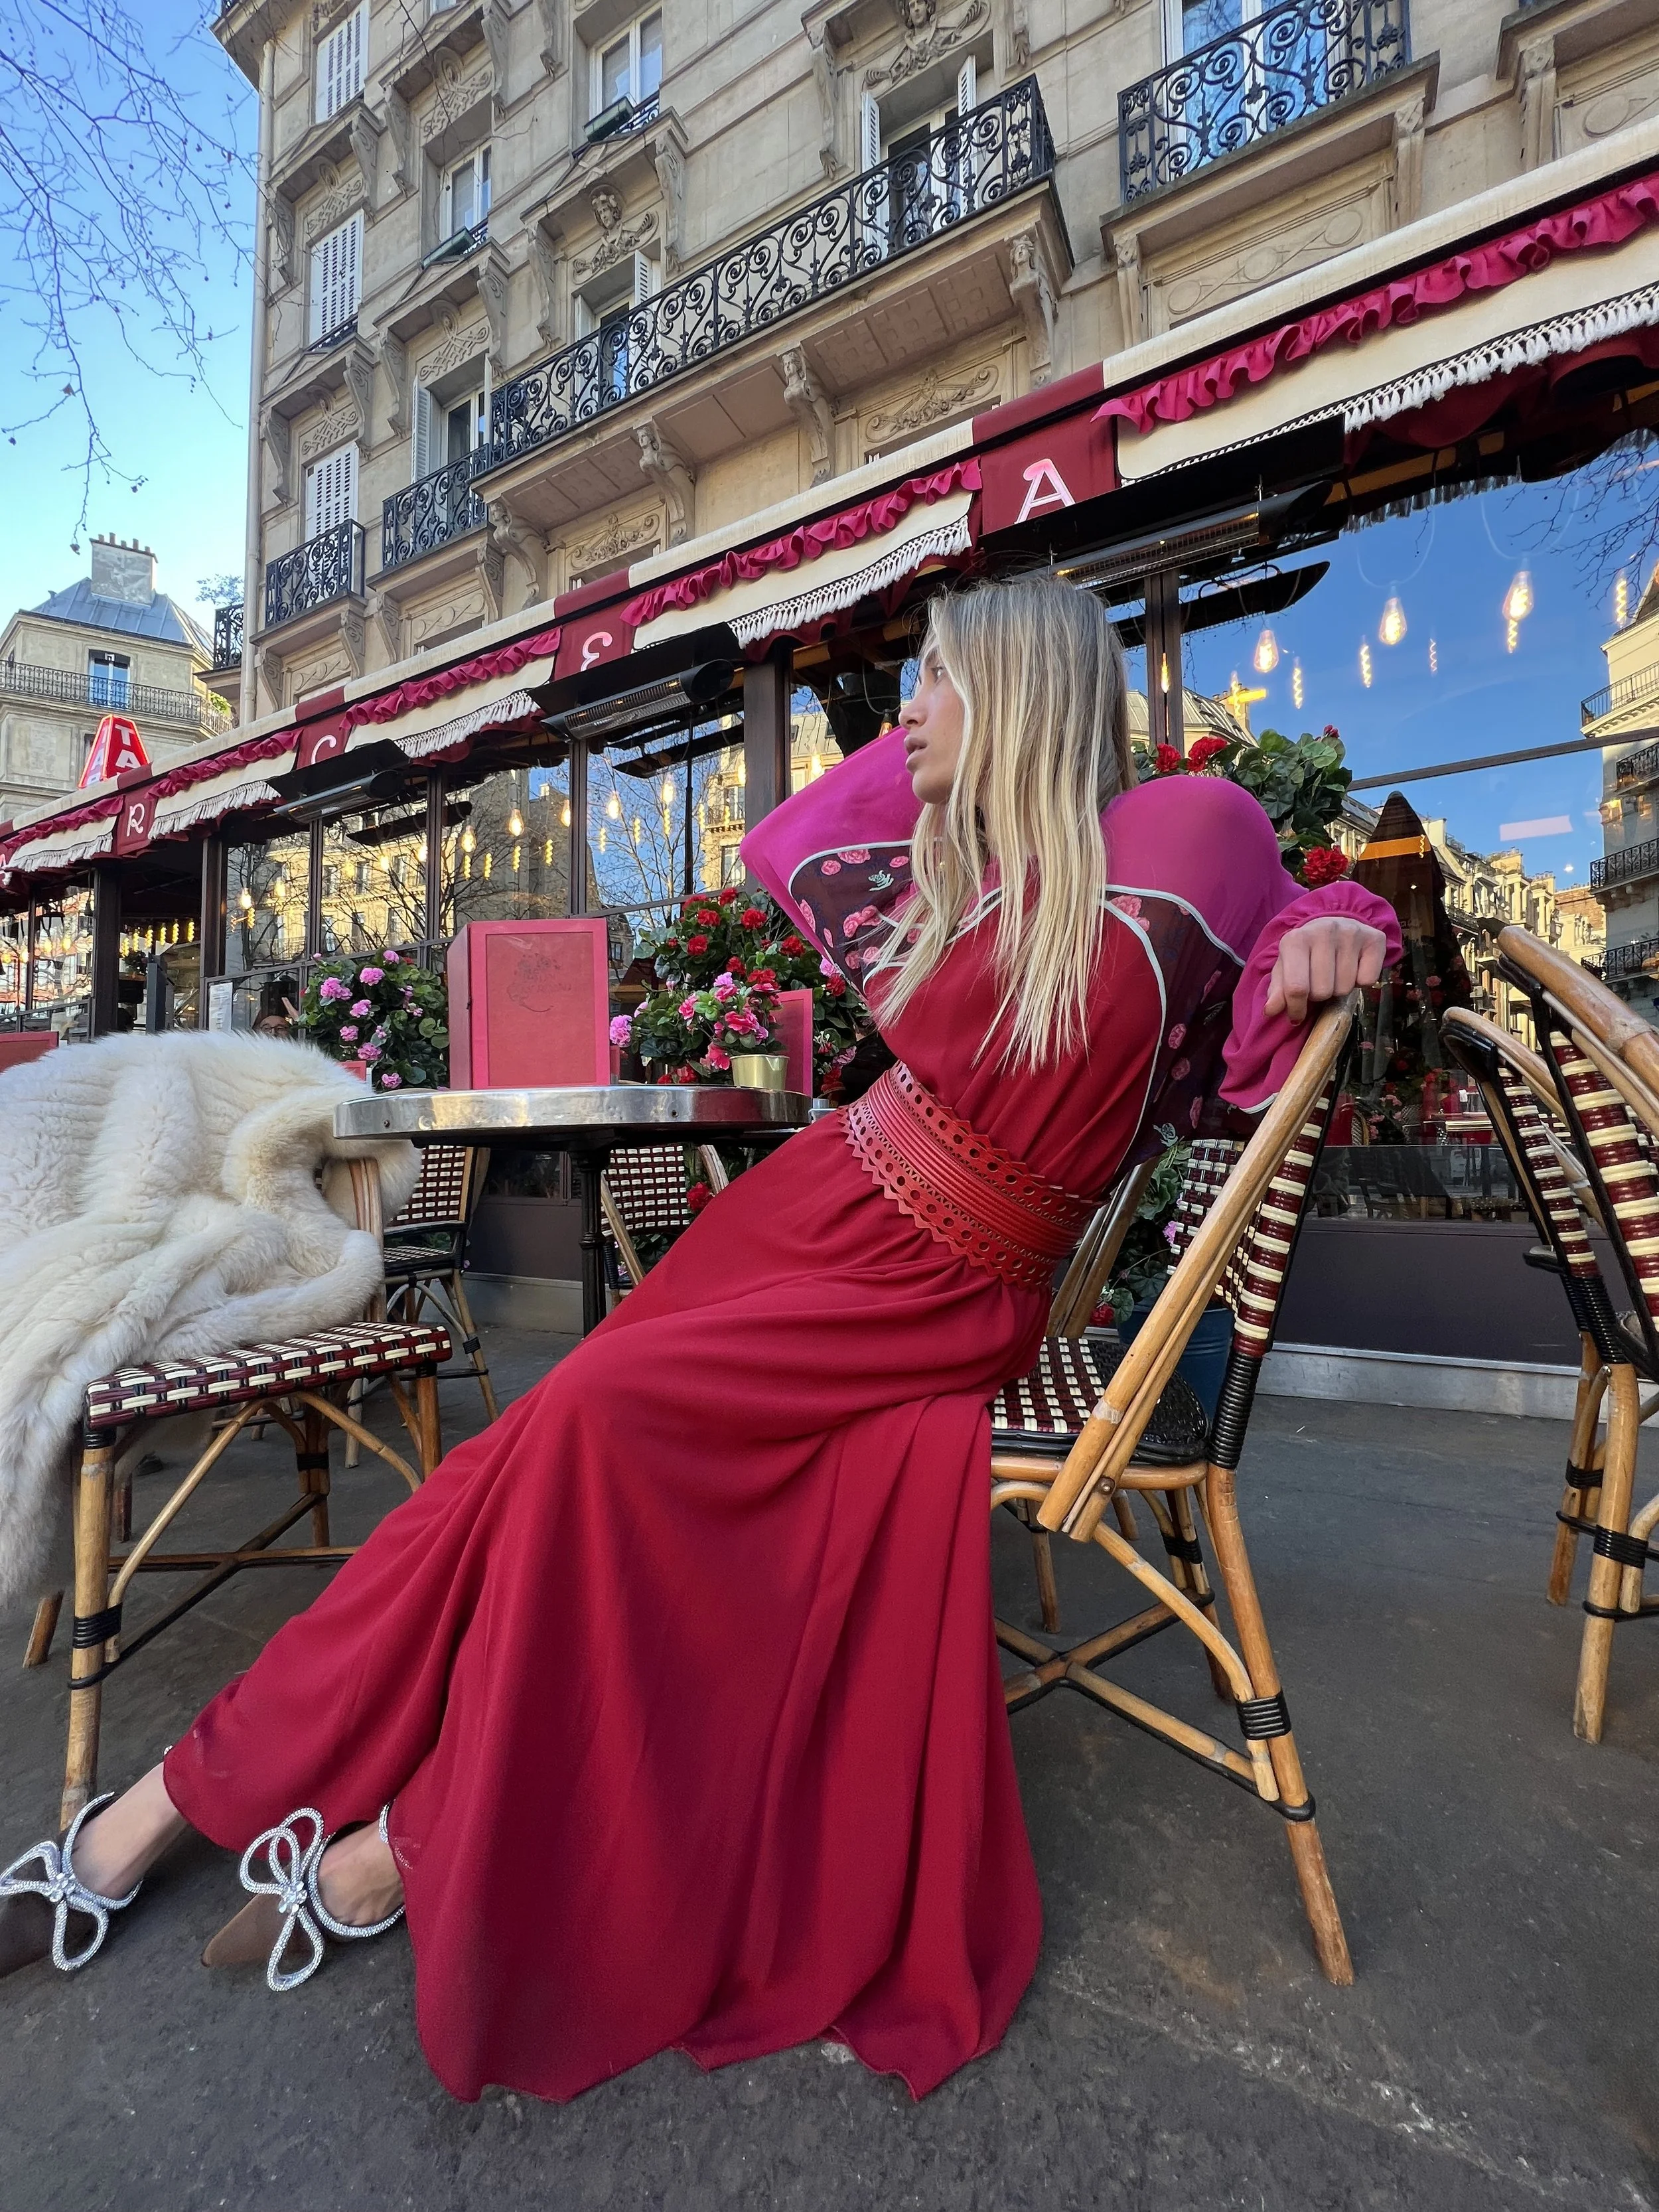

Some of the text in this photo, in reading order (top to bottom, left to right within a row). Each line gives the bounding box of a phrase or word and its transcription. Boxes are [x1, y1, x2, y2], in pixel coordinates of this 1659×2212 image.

[114, 723, 142, 775] TA
[126, 803, 145, 837] R
[1013, 458, 1076, 525] A
